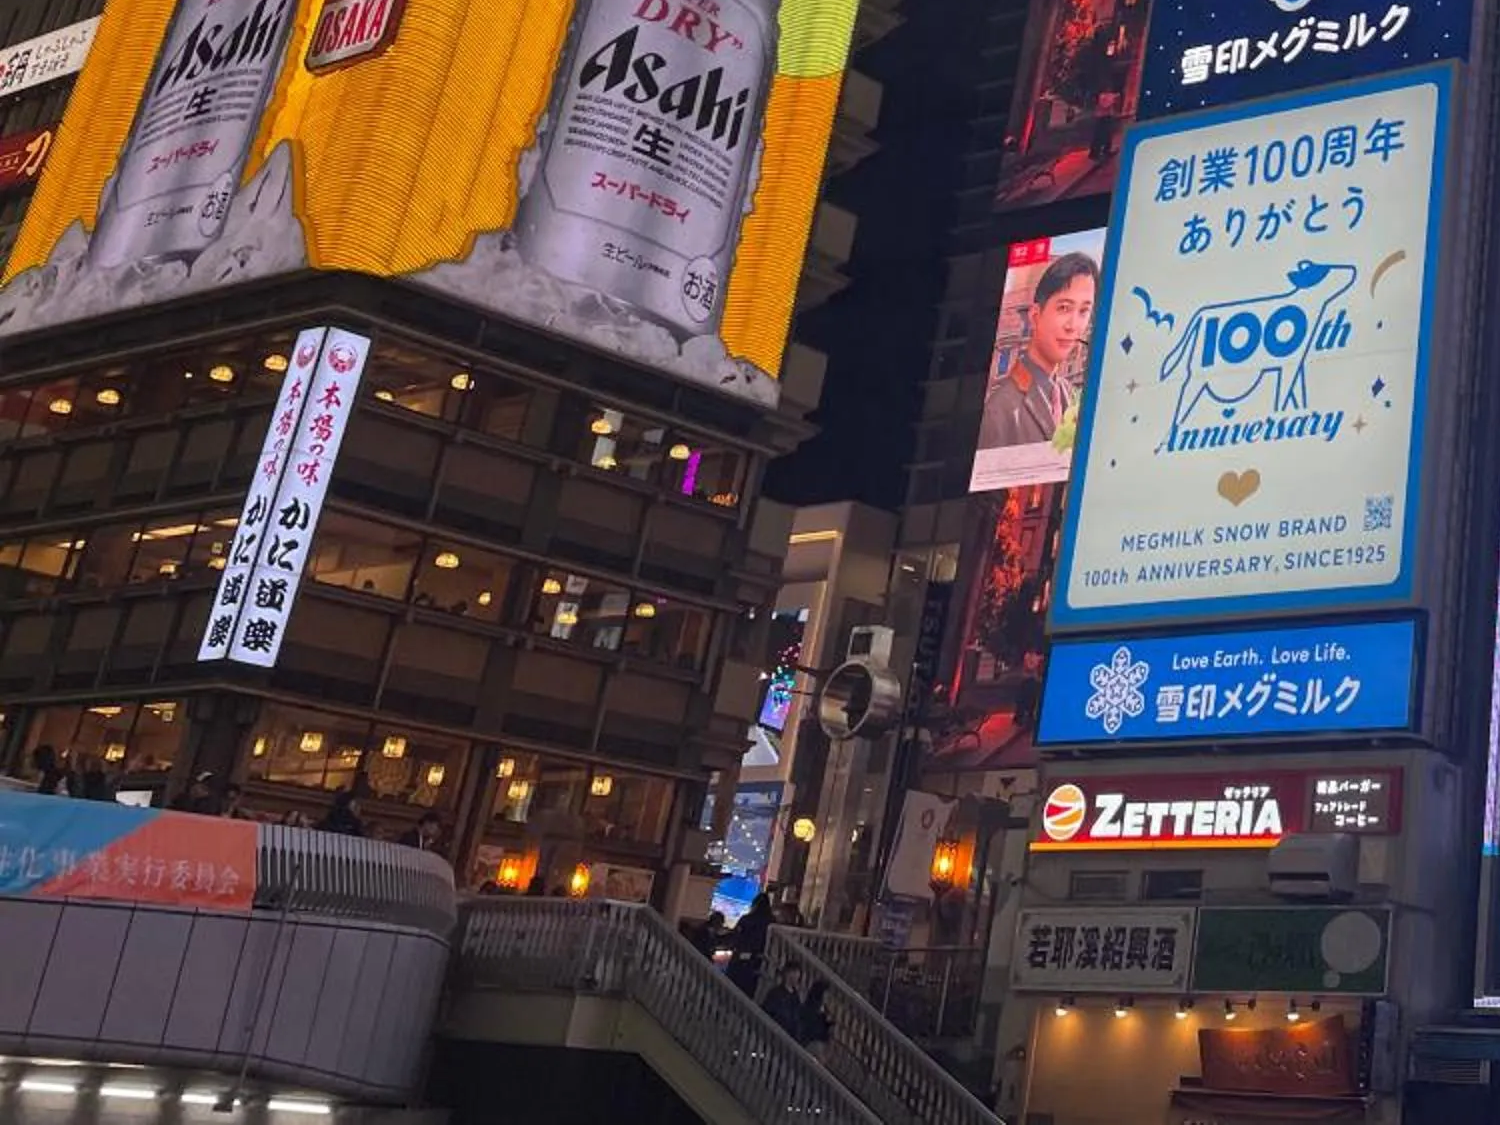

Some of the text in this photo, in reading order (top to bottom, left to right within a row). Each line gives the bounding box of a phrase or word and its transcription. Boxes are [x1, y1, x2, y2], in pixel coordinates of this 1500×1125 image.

[1180, 3, 1411, 85] 雪印メグミルク
[183, 86, 217, 121] 生
[579, 24, 750, 151] Asahi
[631, 123, 675, 166] 生
[1154, 117, 1406, 203] 創業100周年
[591, 171, 691, 224] スーパードライ
[1178, 185, 1368, 255] ありがとう
[295, 380, 343, 488] 本場の味
[1154, 410, 1344, 455] Anniversary
[1120, 515, 1347, 553] MEGMILK SNOW BRAND
[1083, 569, 1129, 588] 100th
[1173, 642, 1351, 671] Love Earth. Love Life.
[1156, 673, 1361, 723] 雪印メグミルク
[1334, 813, 1379, 828] コーヒー
